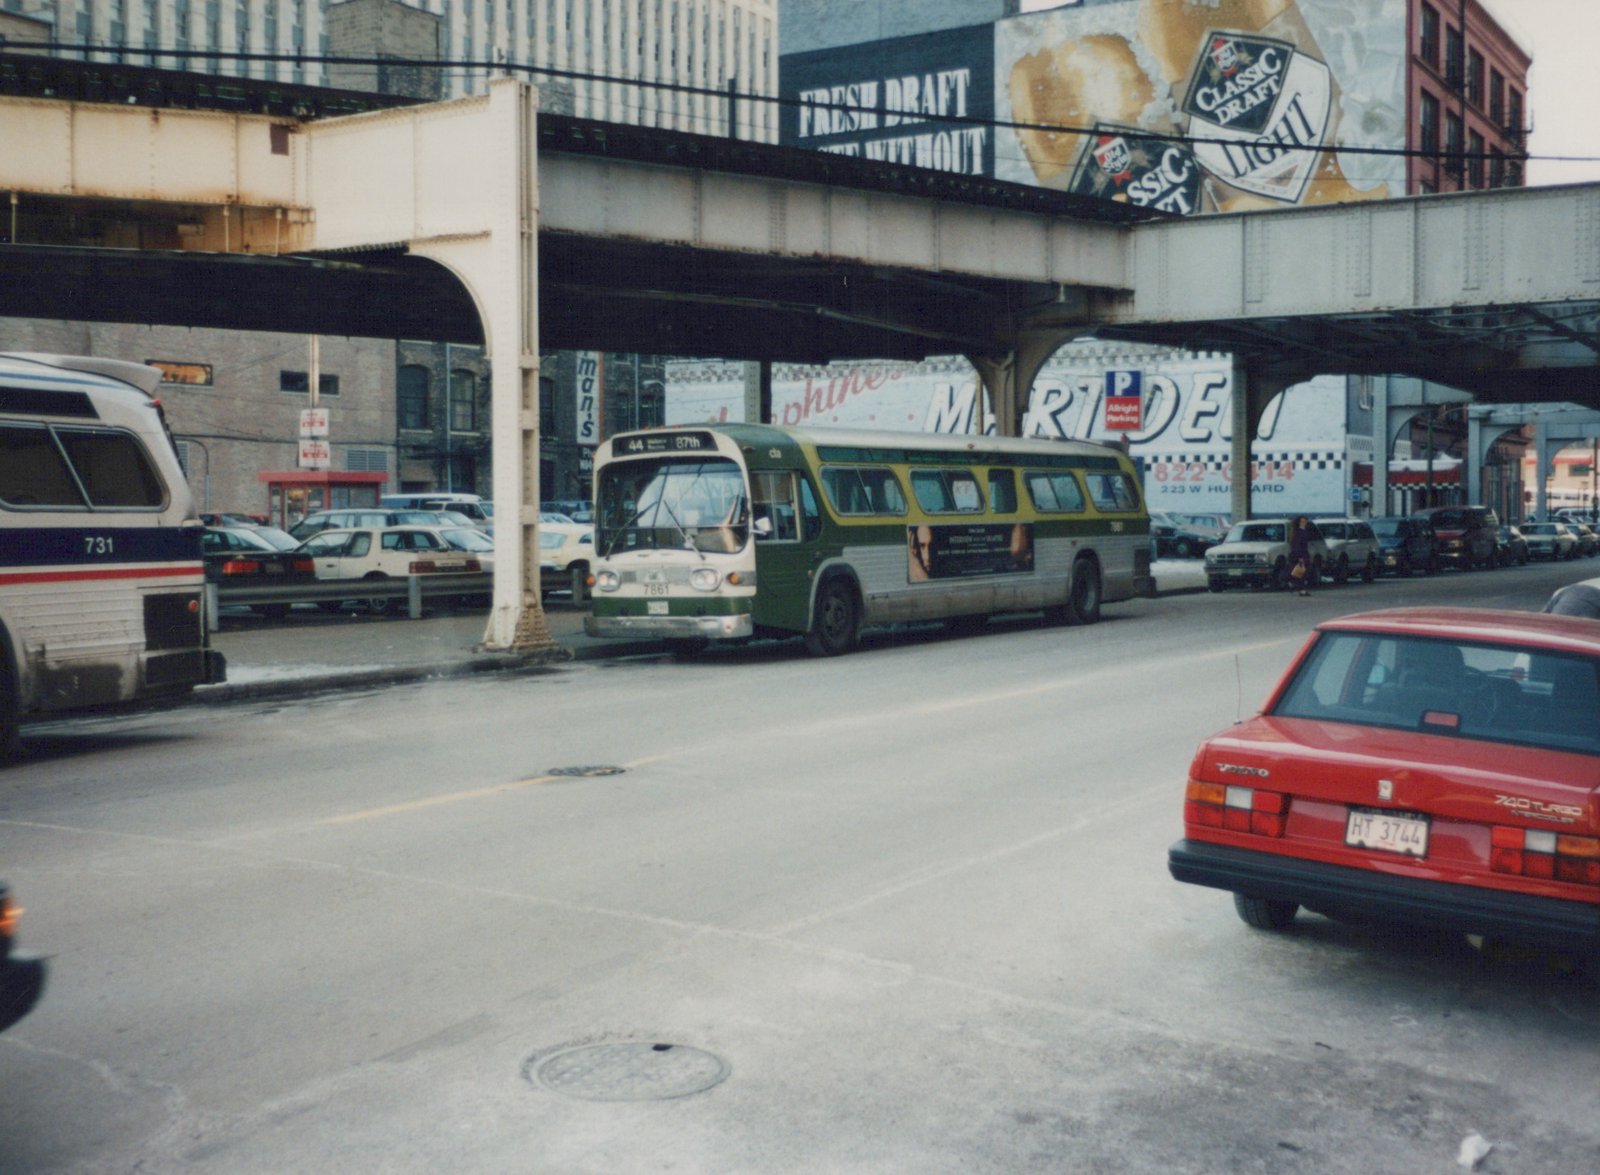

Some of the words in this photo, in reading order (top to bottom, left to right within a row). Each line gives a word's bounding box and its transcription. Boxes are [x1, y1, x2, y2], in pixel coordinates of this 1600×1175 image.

[1196, 48, 1282, 111] CLASSIC
[799, 81, 879, 138] FRESH
[884, 68, 970, 128] DRAFT
[1215, 75, 1280, 125] DRAFT
[1222, 92, 1316, 178] LIGHT
[1103, 145, 1122, 162] Old
[1127, 148, 1192, 207] SSIC
[579, 352, 597, 438] man's
[1114, 371, 1132, 396] P
[923, 376, 1104, 439] MRT
[1107, 414, 1139, 424] Parking
[1108, 404, 1139, 414] Allright
[628, 439, 644, 451] 44
[676, 436, 700, 449] 87th
[1161, 485, 1185, 493] 223
[1189, 485, 1201, 493] W
[1208, 484, 1284, 493] HUARD
[85, 536, 114, 554] 731
[643, 583, 670, 596] 7861
[1495, 794, 1530, 809] 740
[1531, 801, 1582, 816] TURBO
[1352, 815, 1373, 838] HT
[1380, 820, 1421, 845] 3744
